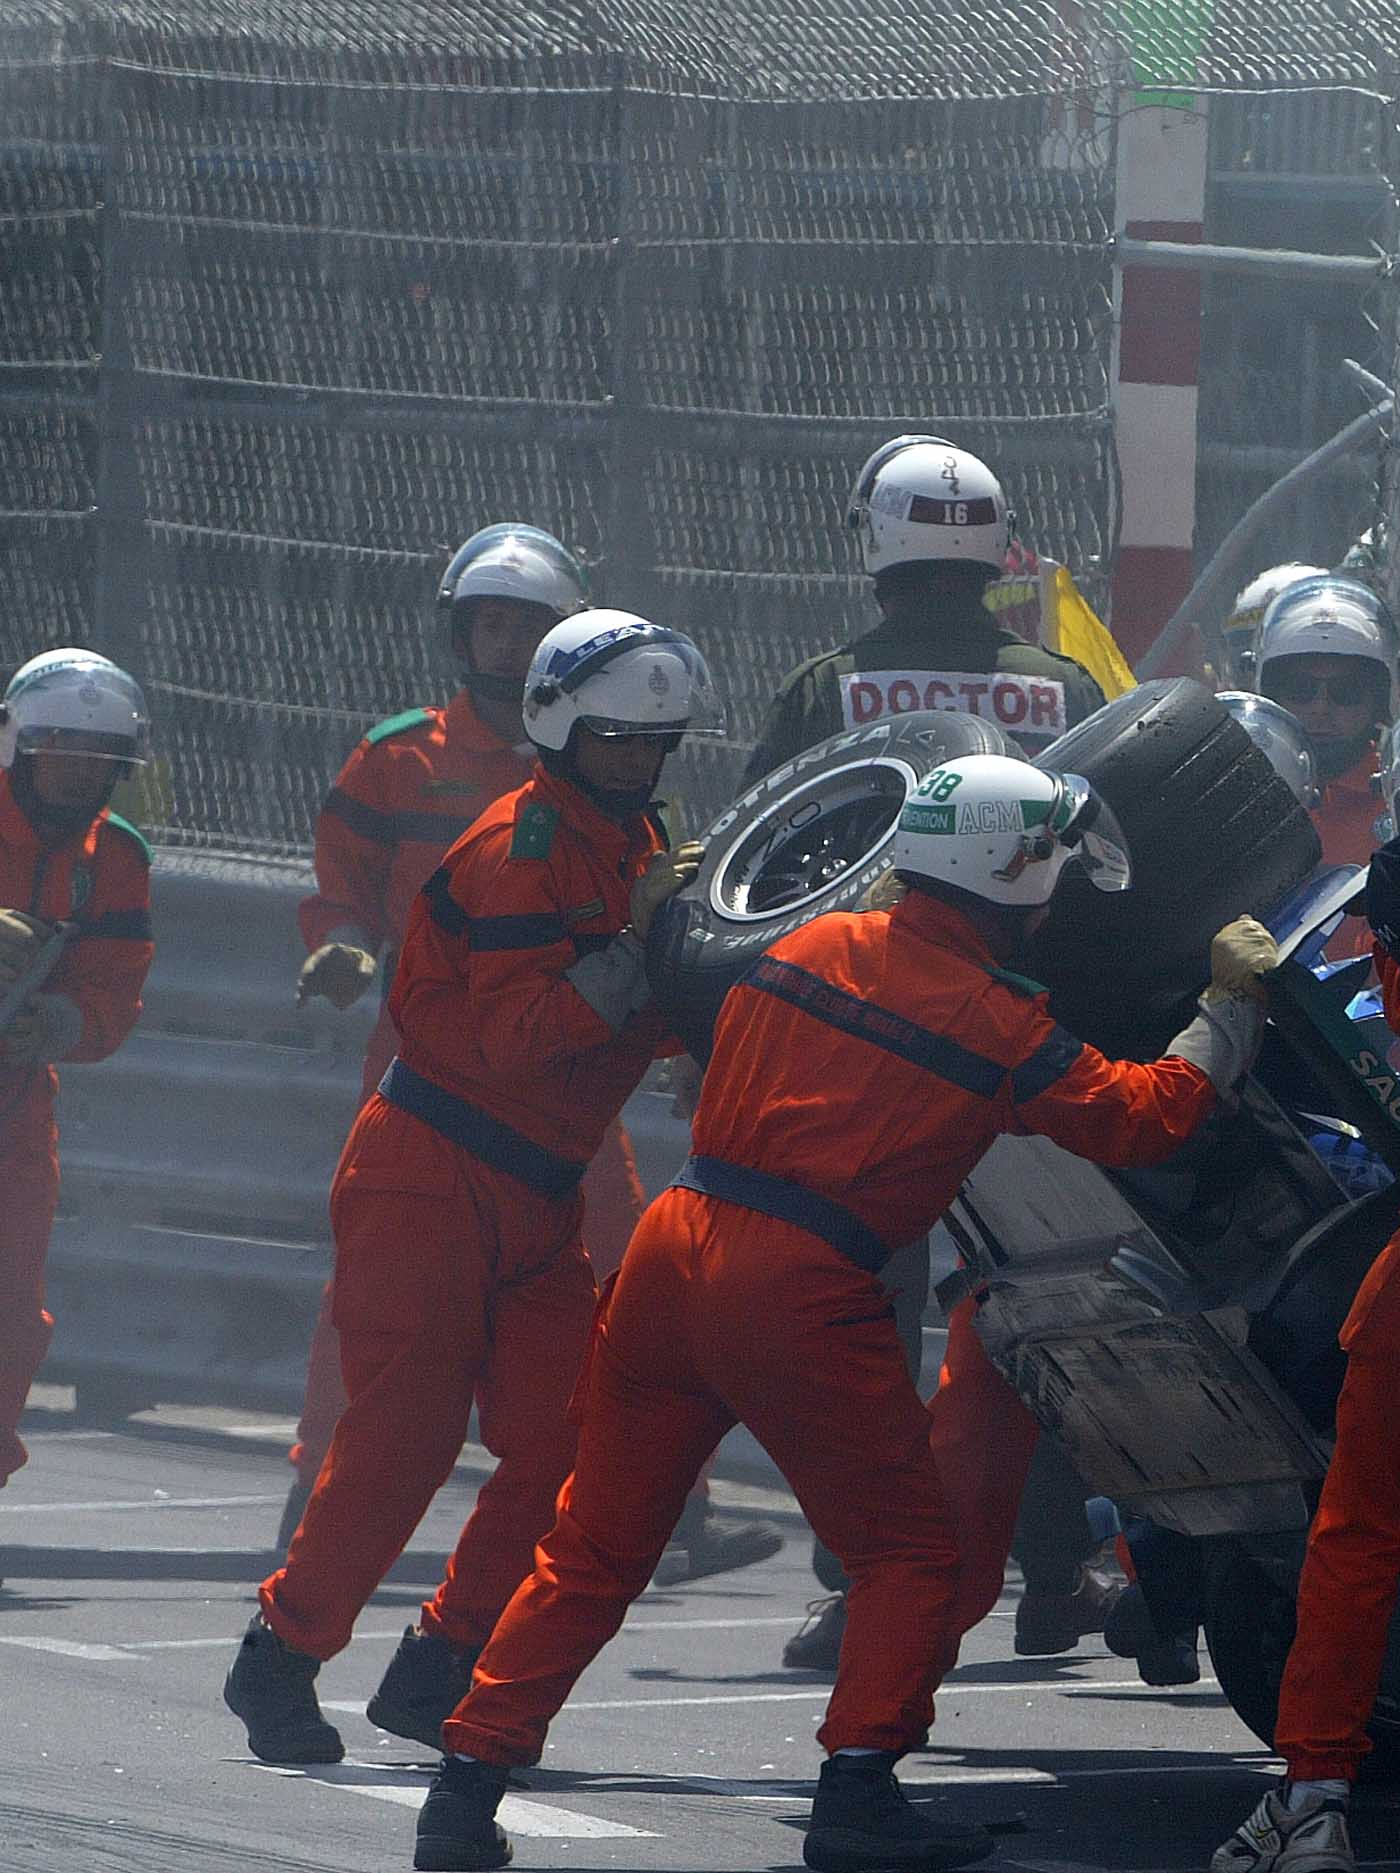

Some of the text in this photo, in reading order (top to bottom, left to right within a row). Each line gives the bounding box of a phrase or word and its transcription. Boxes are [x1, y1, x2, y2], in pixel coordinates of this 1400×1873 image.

[944, 502, 969, 524] 16
[850, 679, 1059, 727] DOCTOR
[957, 801, 1024, 835] ACM
